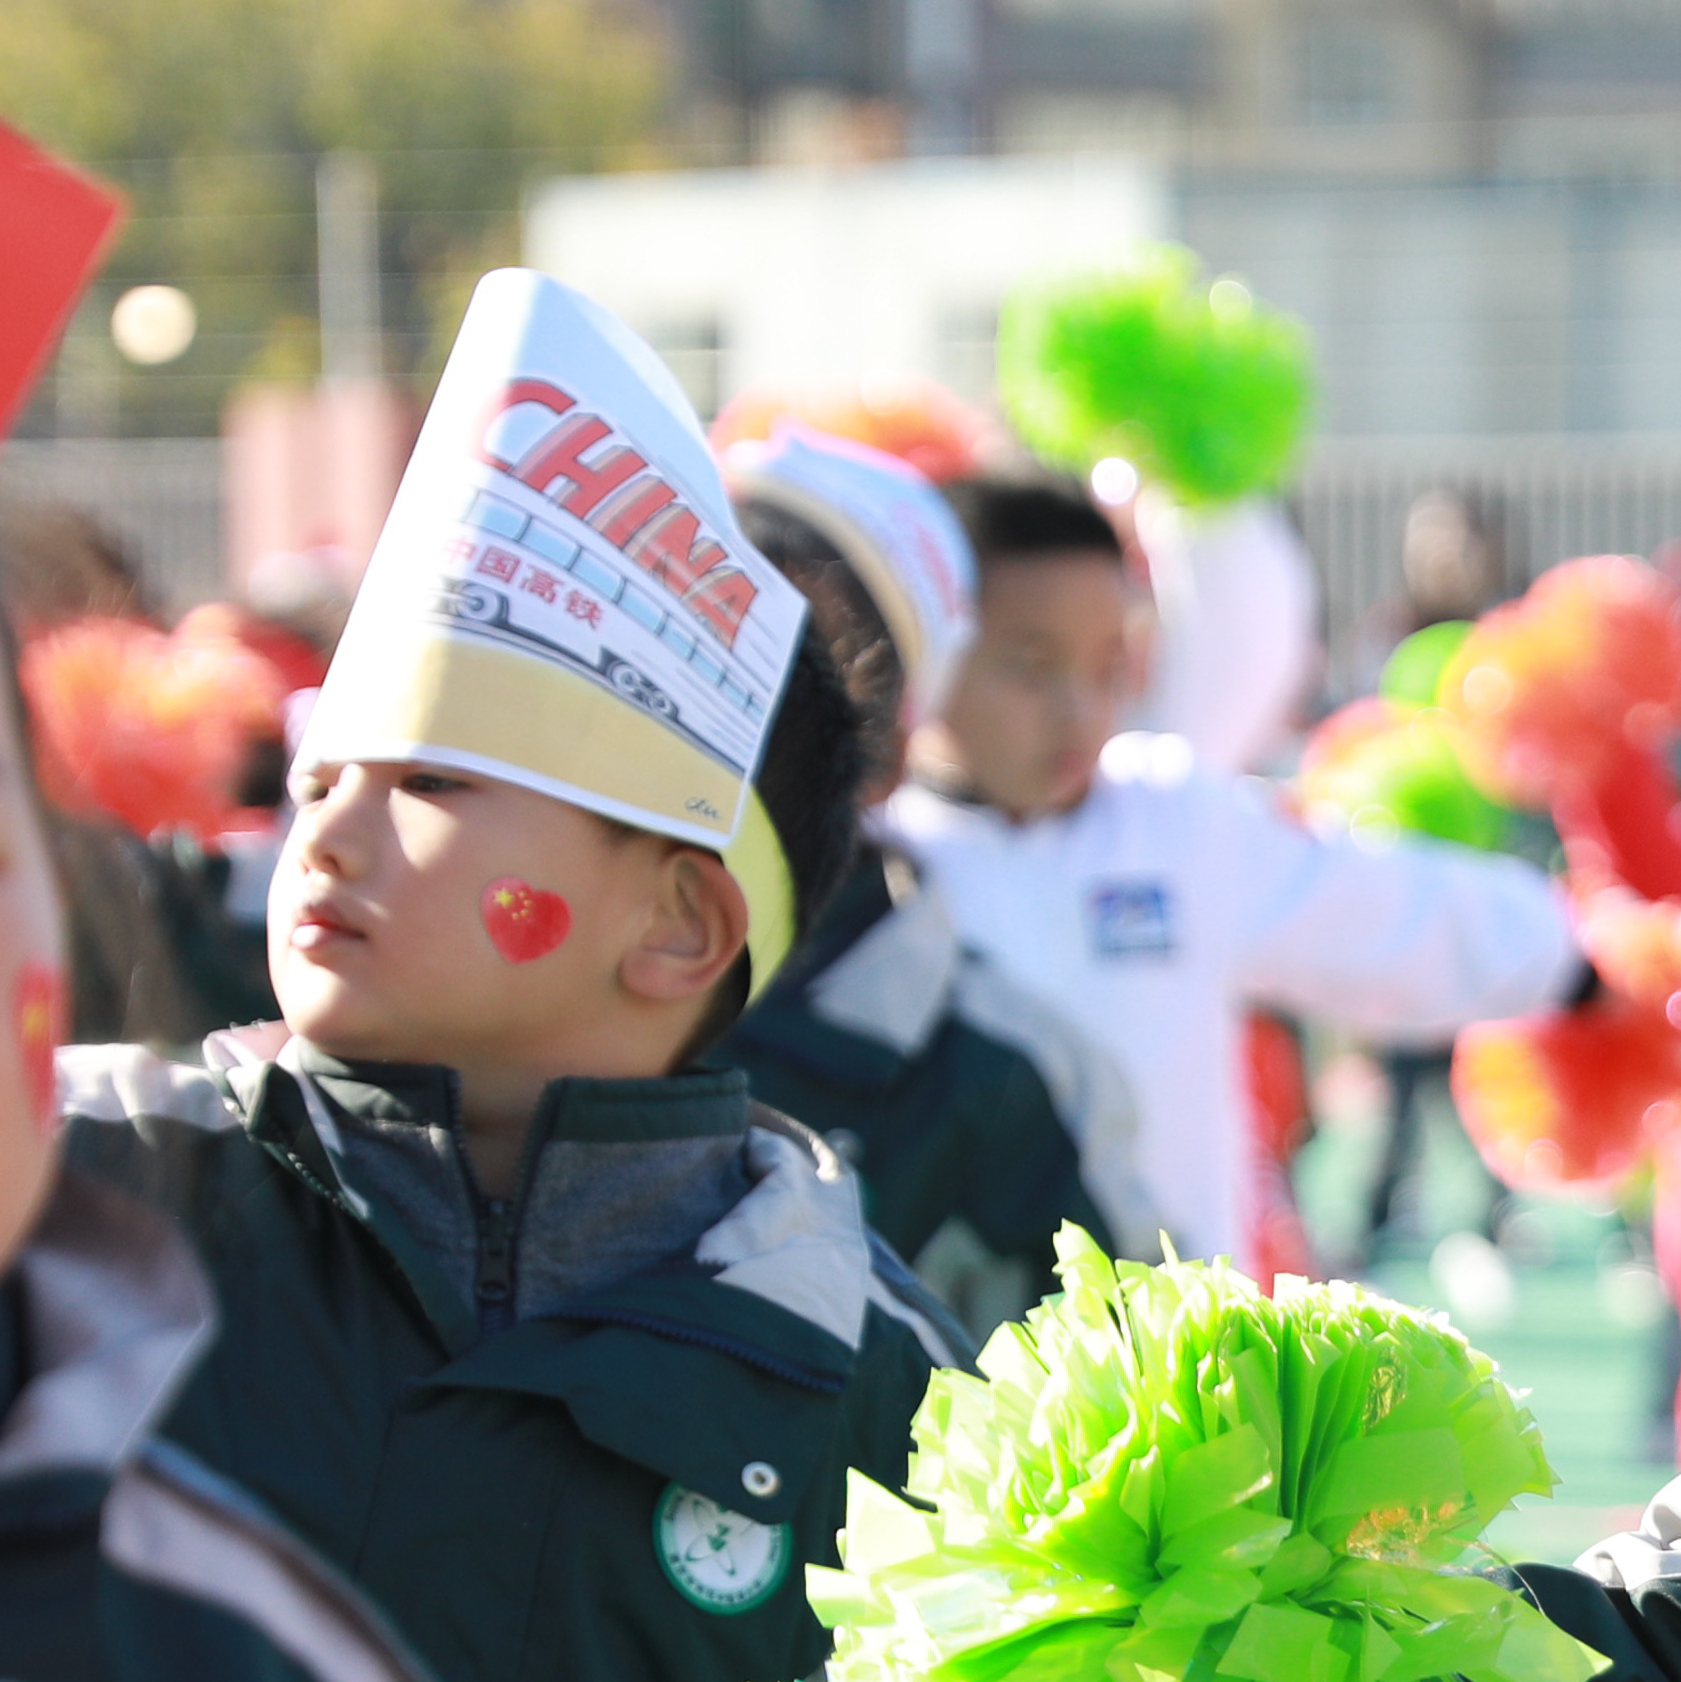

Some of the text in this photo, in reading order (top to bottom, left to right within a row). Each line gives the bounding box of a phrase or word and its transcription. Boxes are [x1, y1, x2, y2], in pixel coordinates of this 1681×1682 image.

[443, 540, 603, 631] 中国高铁
[474, 378, 758, 652] CHINA
